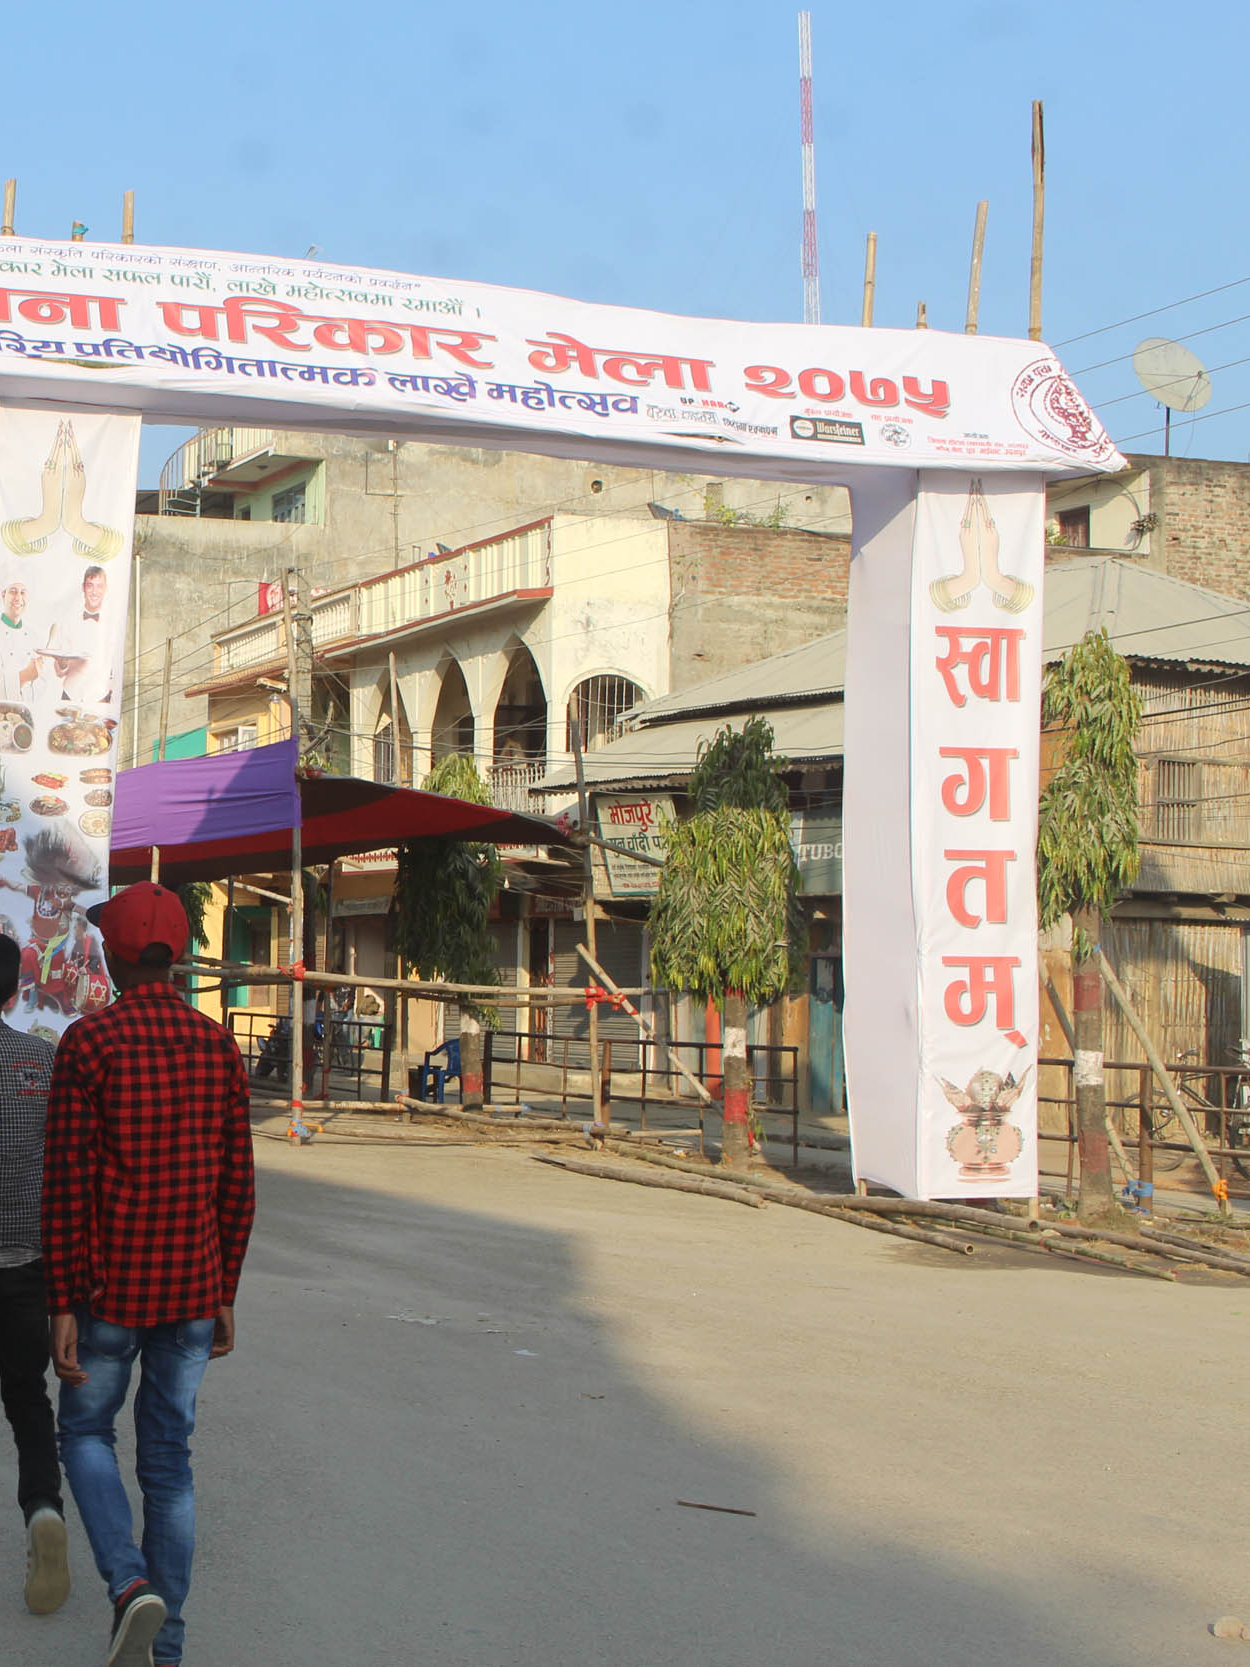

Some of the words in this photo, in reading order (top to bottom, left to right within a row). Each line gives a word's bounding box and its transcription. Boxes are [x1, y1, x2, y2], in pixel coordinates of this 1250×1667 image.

[51, 259, 94, 279] मेला
[101, 268, 162, 285] सफल
[226, 277, 278, 295] लाखे
[72, 338, 378, 386] प्रतियोगितात्मक
[384, 371, 477, 402] लाखे
[485, 380, 640, 417] महोत्सव
[155, 296, 498, 370] परिकार
[525, 332, 715, 393] मेला
[743, 364, 951, 419] २०७५
